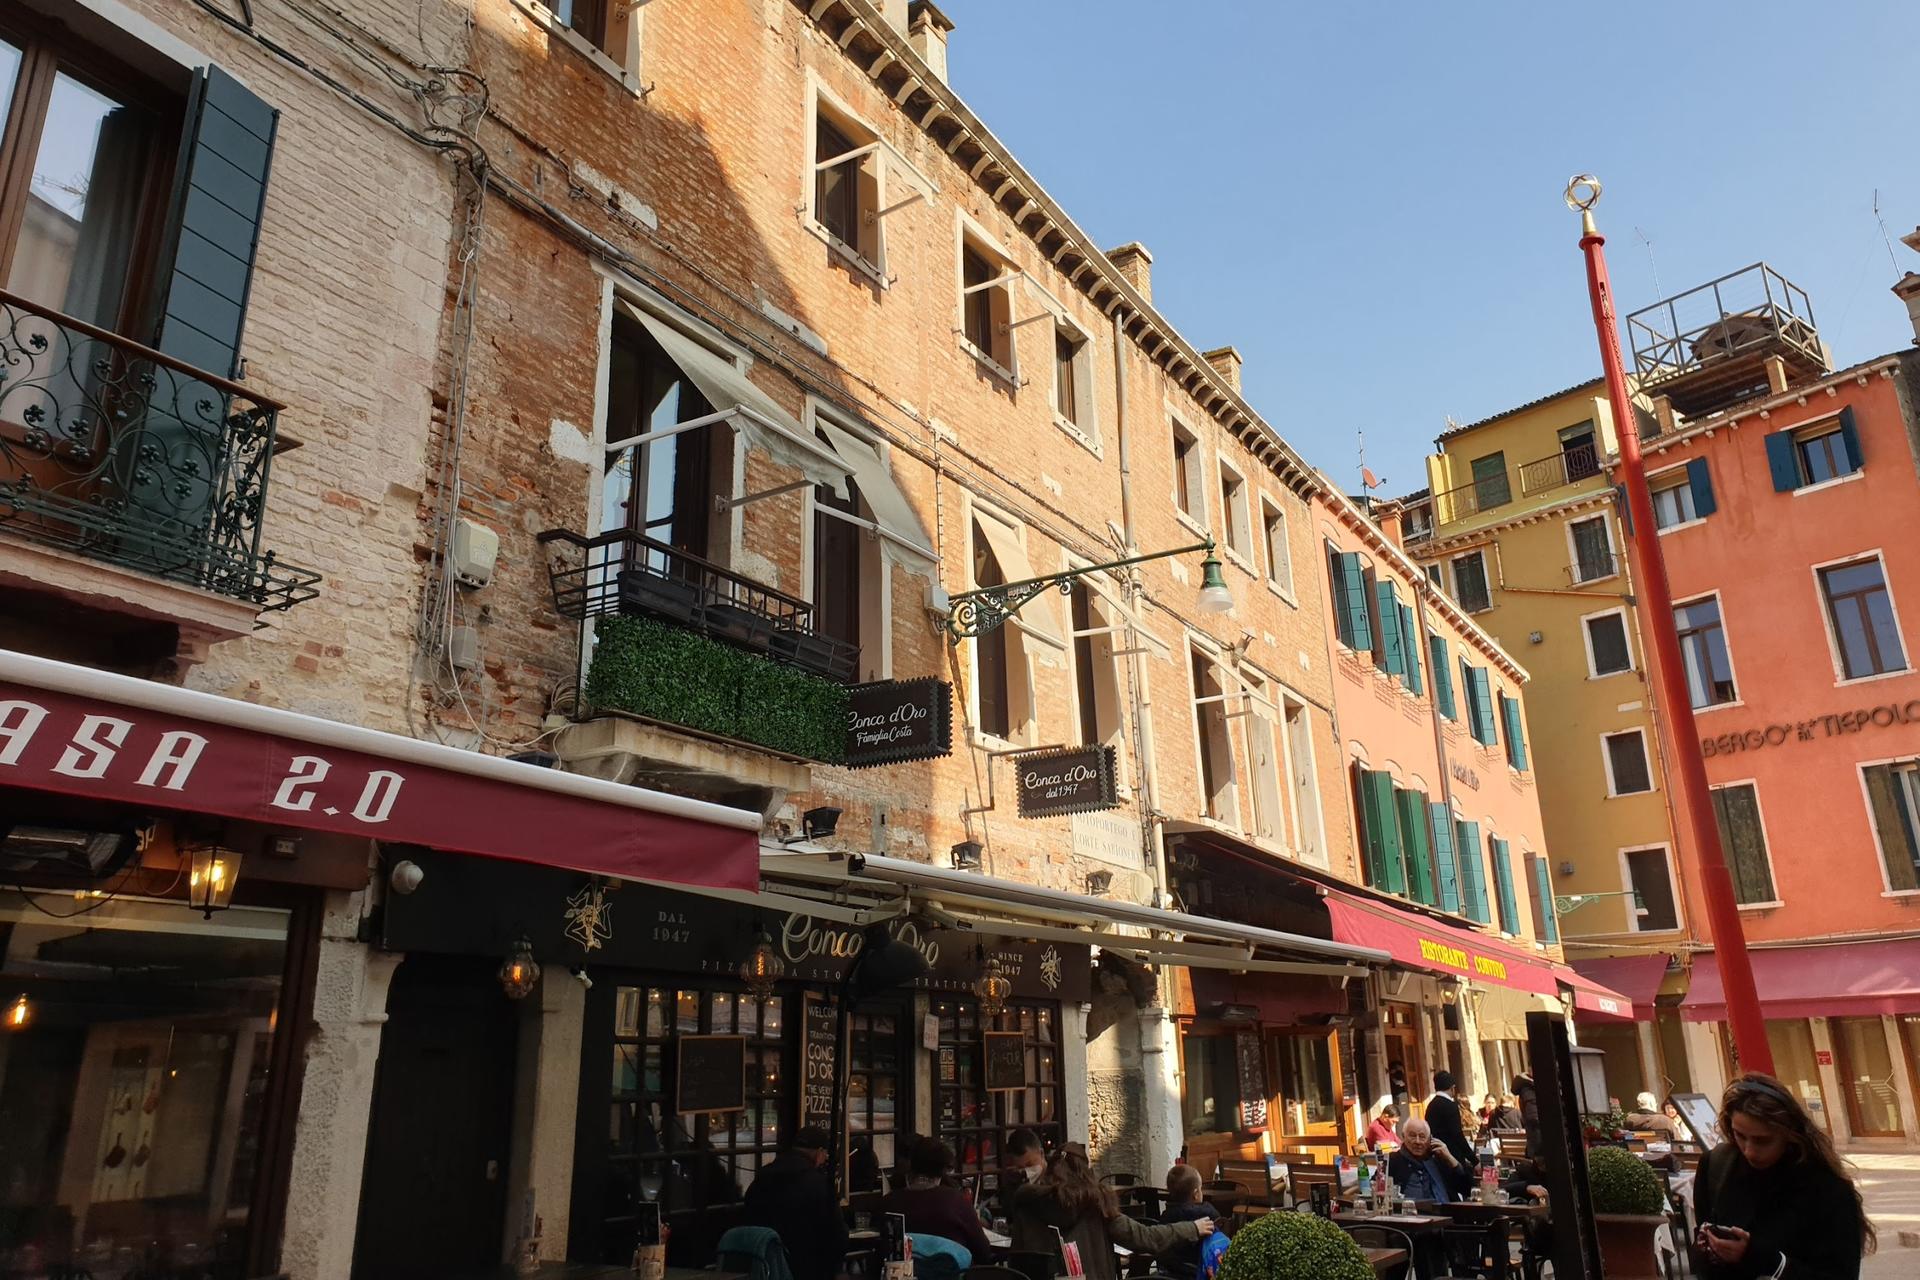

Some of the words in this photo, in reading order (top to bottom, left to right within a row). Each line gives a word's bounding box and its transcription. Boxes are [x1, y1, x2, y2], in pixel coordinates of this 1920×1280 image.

[890, 703, 927, 722] d'Oro
[857, 729, 888, 747] Famiglia
[889, 724, 912, 742] Costa
[1702, 725, 1786, 757] BERGO
[1024, 771, 1061, 789] Conca
[1064, 765, 1097, 782] d'Oro
[270, 756, 406, 823] 2.0
[1046, 788, 1058, 798] dal
[1059, 783, 1078, 796] 1947
[1074, 831, 1099, 849] CORTE
[659, 911, 687, 924] DAL
[653, 927, 691, 942] 1947
[779, 912, 863, 963] Conca
[998, 951, 1024, 963] SINCE
[1418, 938, 1469, 970] RISTORANTE
[1473, 955, 1507, 980] CONVIVIO
[1001, 965, 1021, 976] 1947
[808, 1006, 838, 1018] WELCOM
[808, 1043, 834, 1061] CONC
[809, 1062, 834, 1080] D'OR
